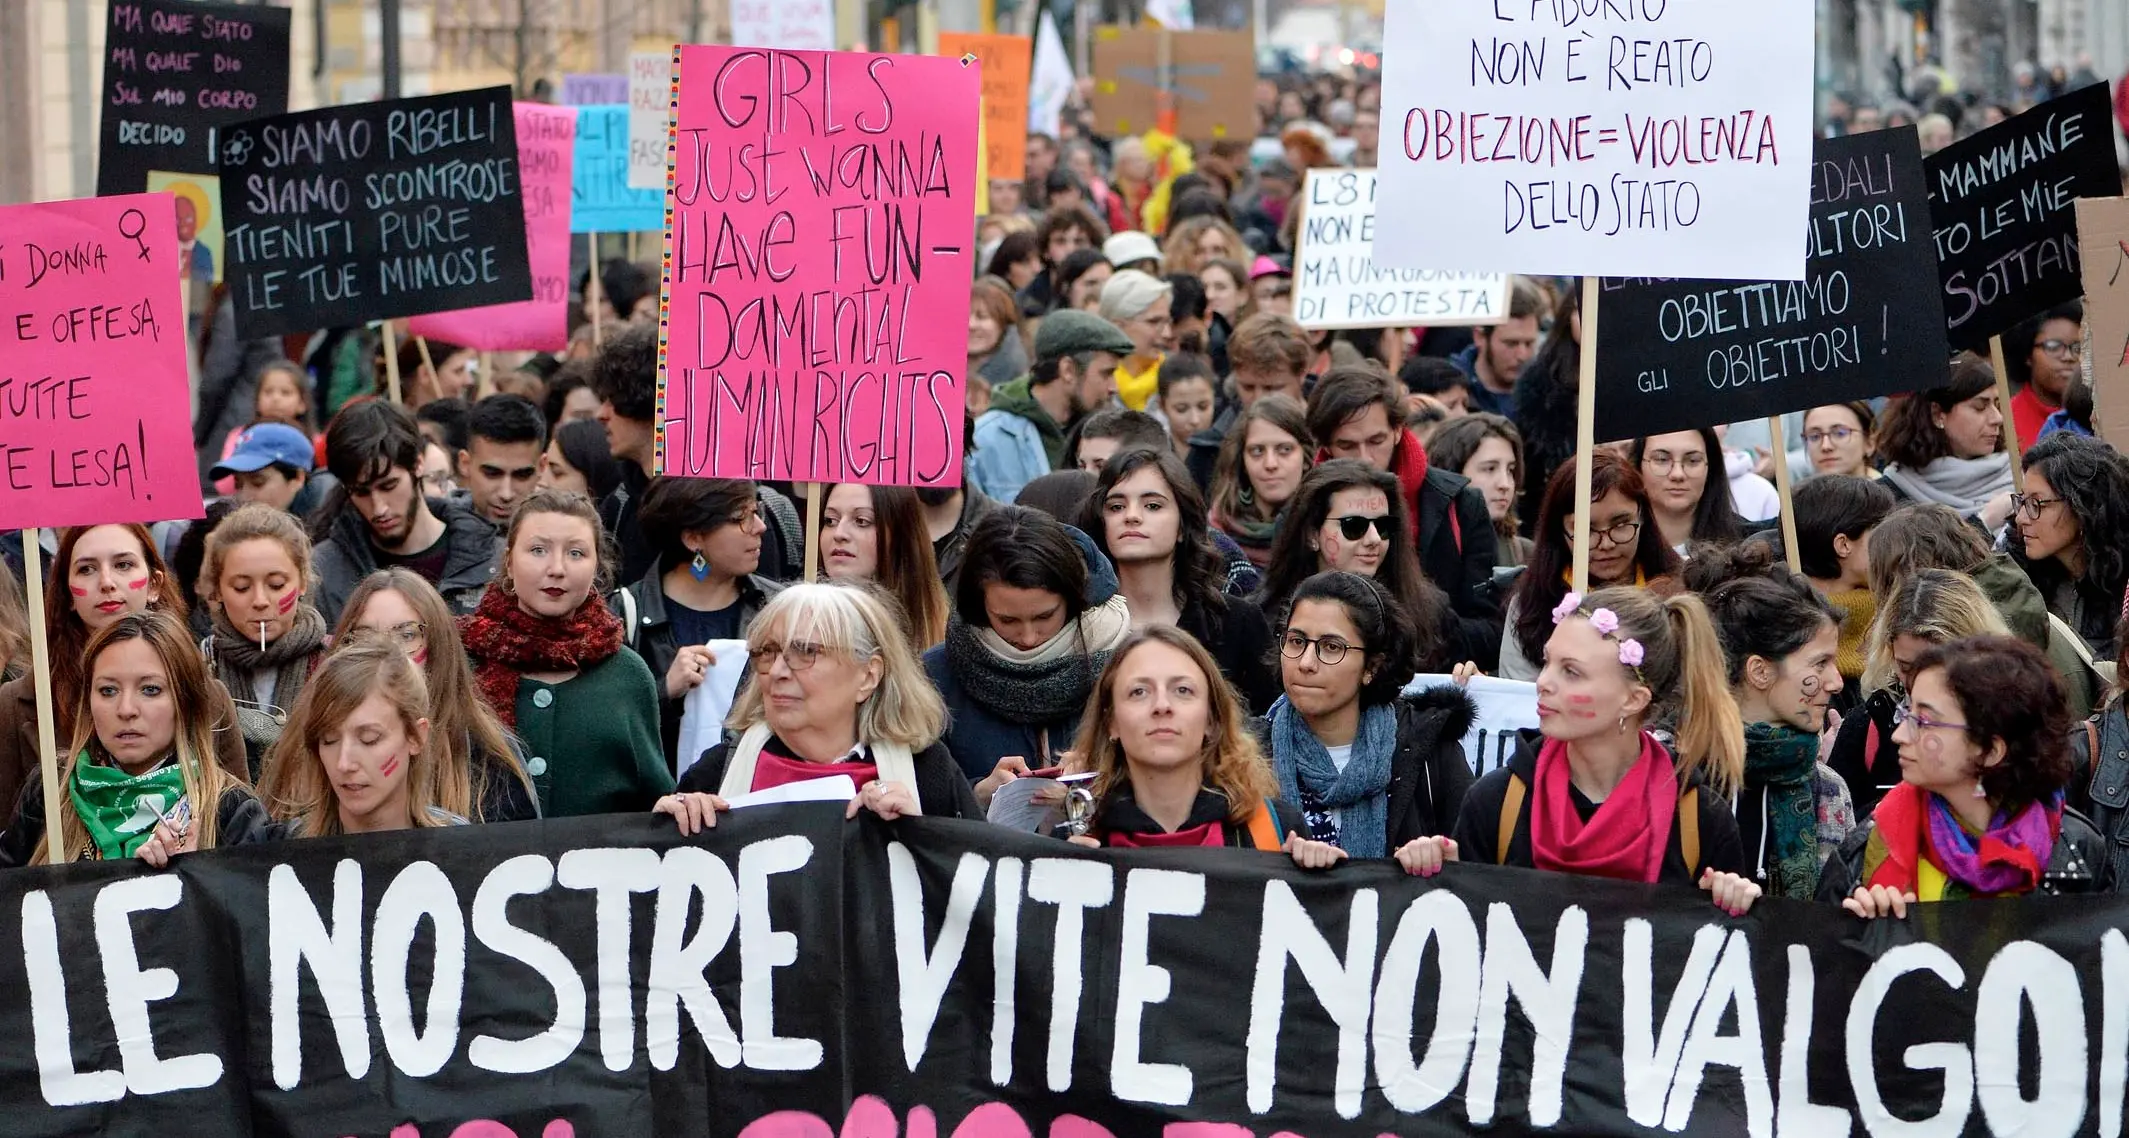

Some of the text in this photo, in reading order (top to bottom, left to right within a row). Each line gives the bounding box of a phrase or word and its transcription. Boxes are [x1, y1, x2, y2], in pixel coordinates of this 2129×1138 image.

[114, 5, 252, 42] MA QUALE STATO
[112, 48, 136, 71] MA
[146, 52, 199, 72] QUALE
[1472, 30, 1712, 91] NON È REATO
[152, 88, 186, 107] MIO
[198, 89, 257, 110] CORPO
[713, 51, 894, 137] GIRLS
[119, 120, 216, 165] DECIDO I
[263, 102, 495, 168] SIAMO RIBELLI
[523, 110, 570, 141] STATO
[631, 139, 667, 167] FAS
[247, 158, 514, 214] SIAMO SCONTROSE
[521, 148, 560, 176] AMO
[1811, 153, 1894, 205] EDALI
[1939, 112, 2084, 204] MAMMANE
[523, 185, 555, 218] ESA
[1306, 213, 1352, 246] NON
[1505, 173, 1700, 236] DELLO STATO
[227, 205, 470, 263] TIENITI PURE
[1932, 222, 1971, 262] TO
[1980, 199, 2017, 241] LE
[25, 241, 107, 288] DONNA
[247, 245, 499, 311] LE TUE MIMOSE
[1303, 256, 1342, 288] MA
[1945, 232, 2079, 330] SOTTAN
[16, 313, 38, 341] E
[1300, 289, 1490, 320] DI PROTESTA
[1659, 270, 1849, 342] OBIETTIAMO
[1637, 368, 1669, 393] GLI
[1707, 325, 1860, 389] OBIETTORI
[663, 367, 955, 484] HUMAN RIGHTS
[51, 418, 152, 501] LESA!
[22, 835, 2129, 1138] LE NOSTRE VITE NON VALGO
